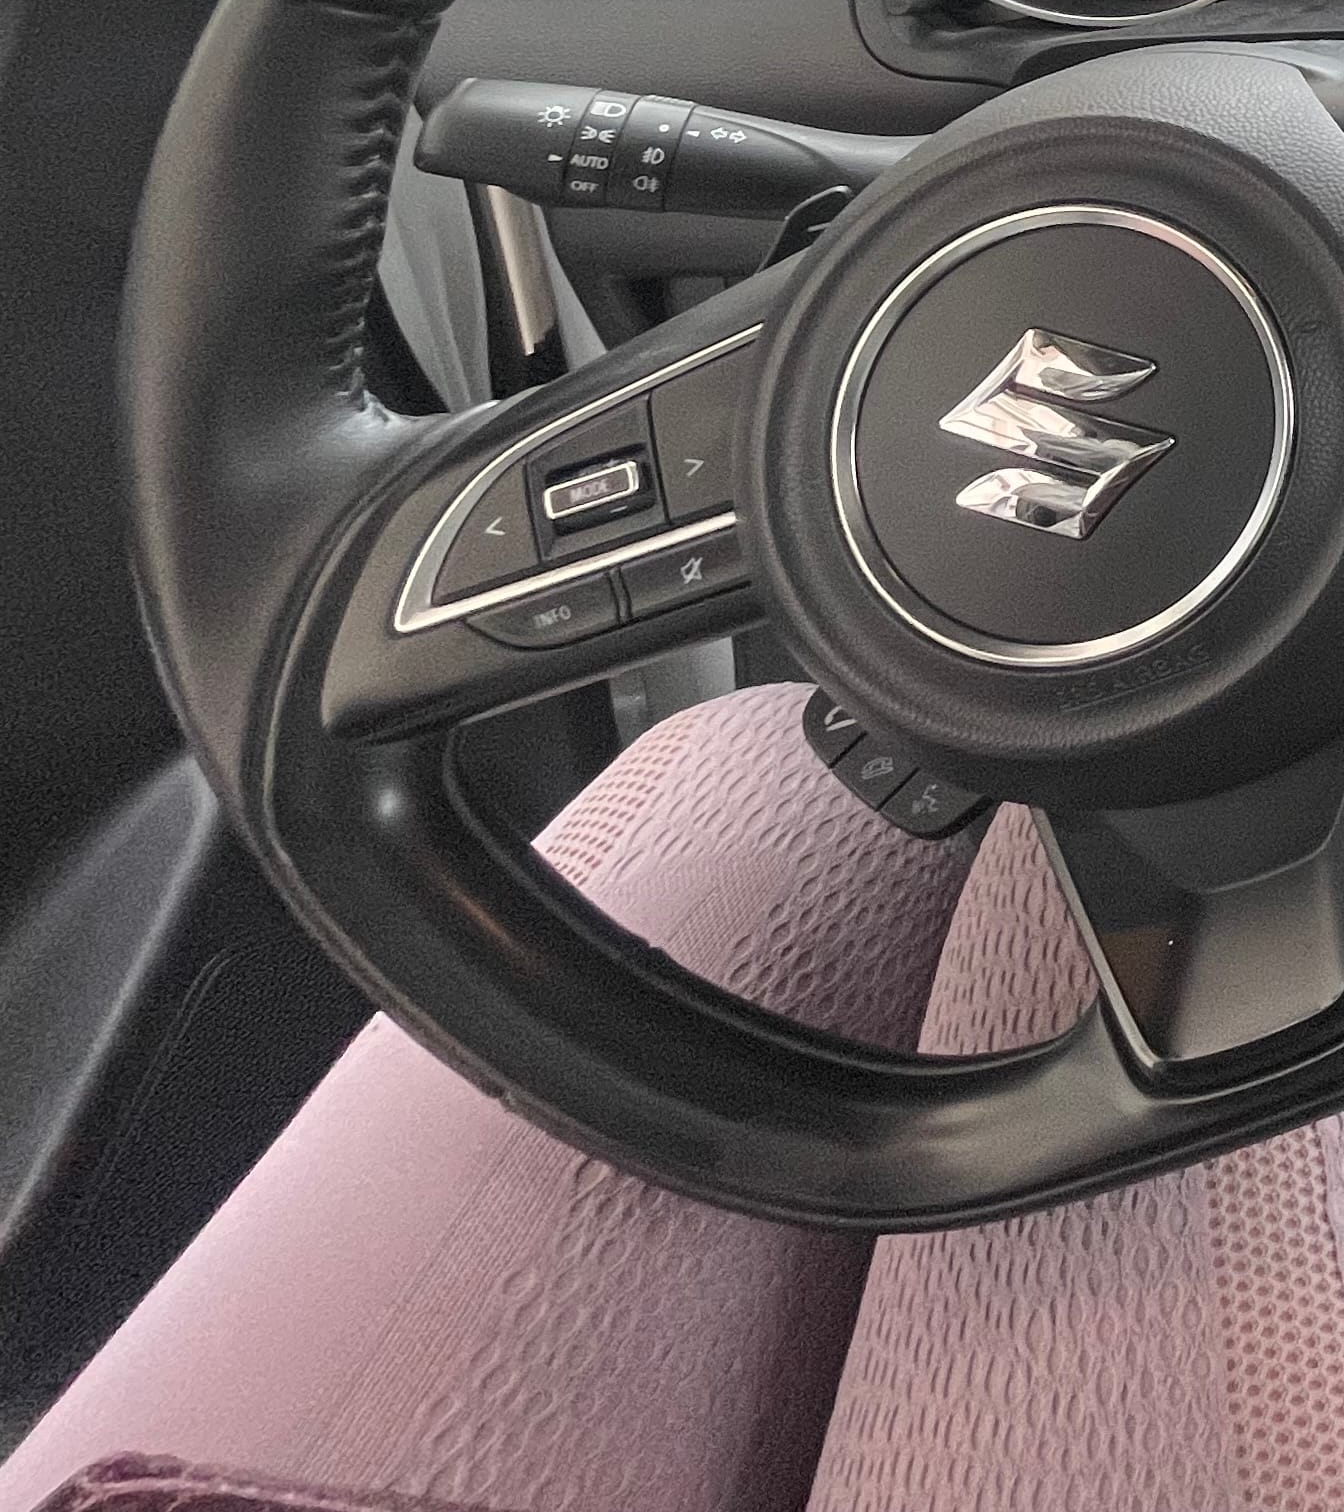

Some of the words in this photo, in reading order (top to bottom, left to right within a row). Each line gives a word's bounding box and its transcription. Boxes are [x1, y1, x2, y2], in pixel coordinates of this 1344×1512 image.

[570, 153, 609, 171] AUTO
[570, 180, 600, 193] OFF
[570, 478, 609, 503] MODE
[534, 605, 572, 628] INFO
